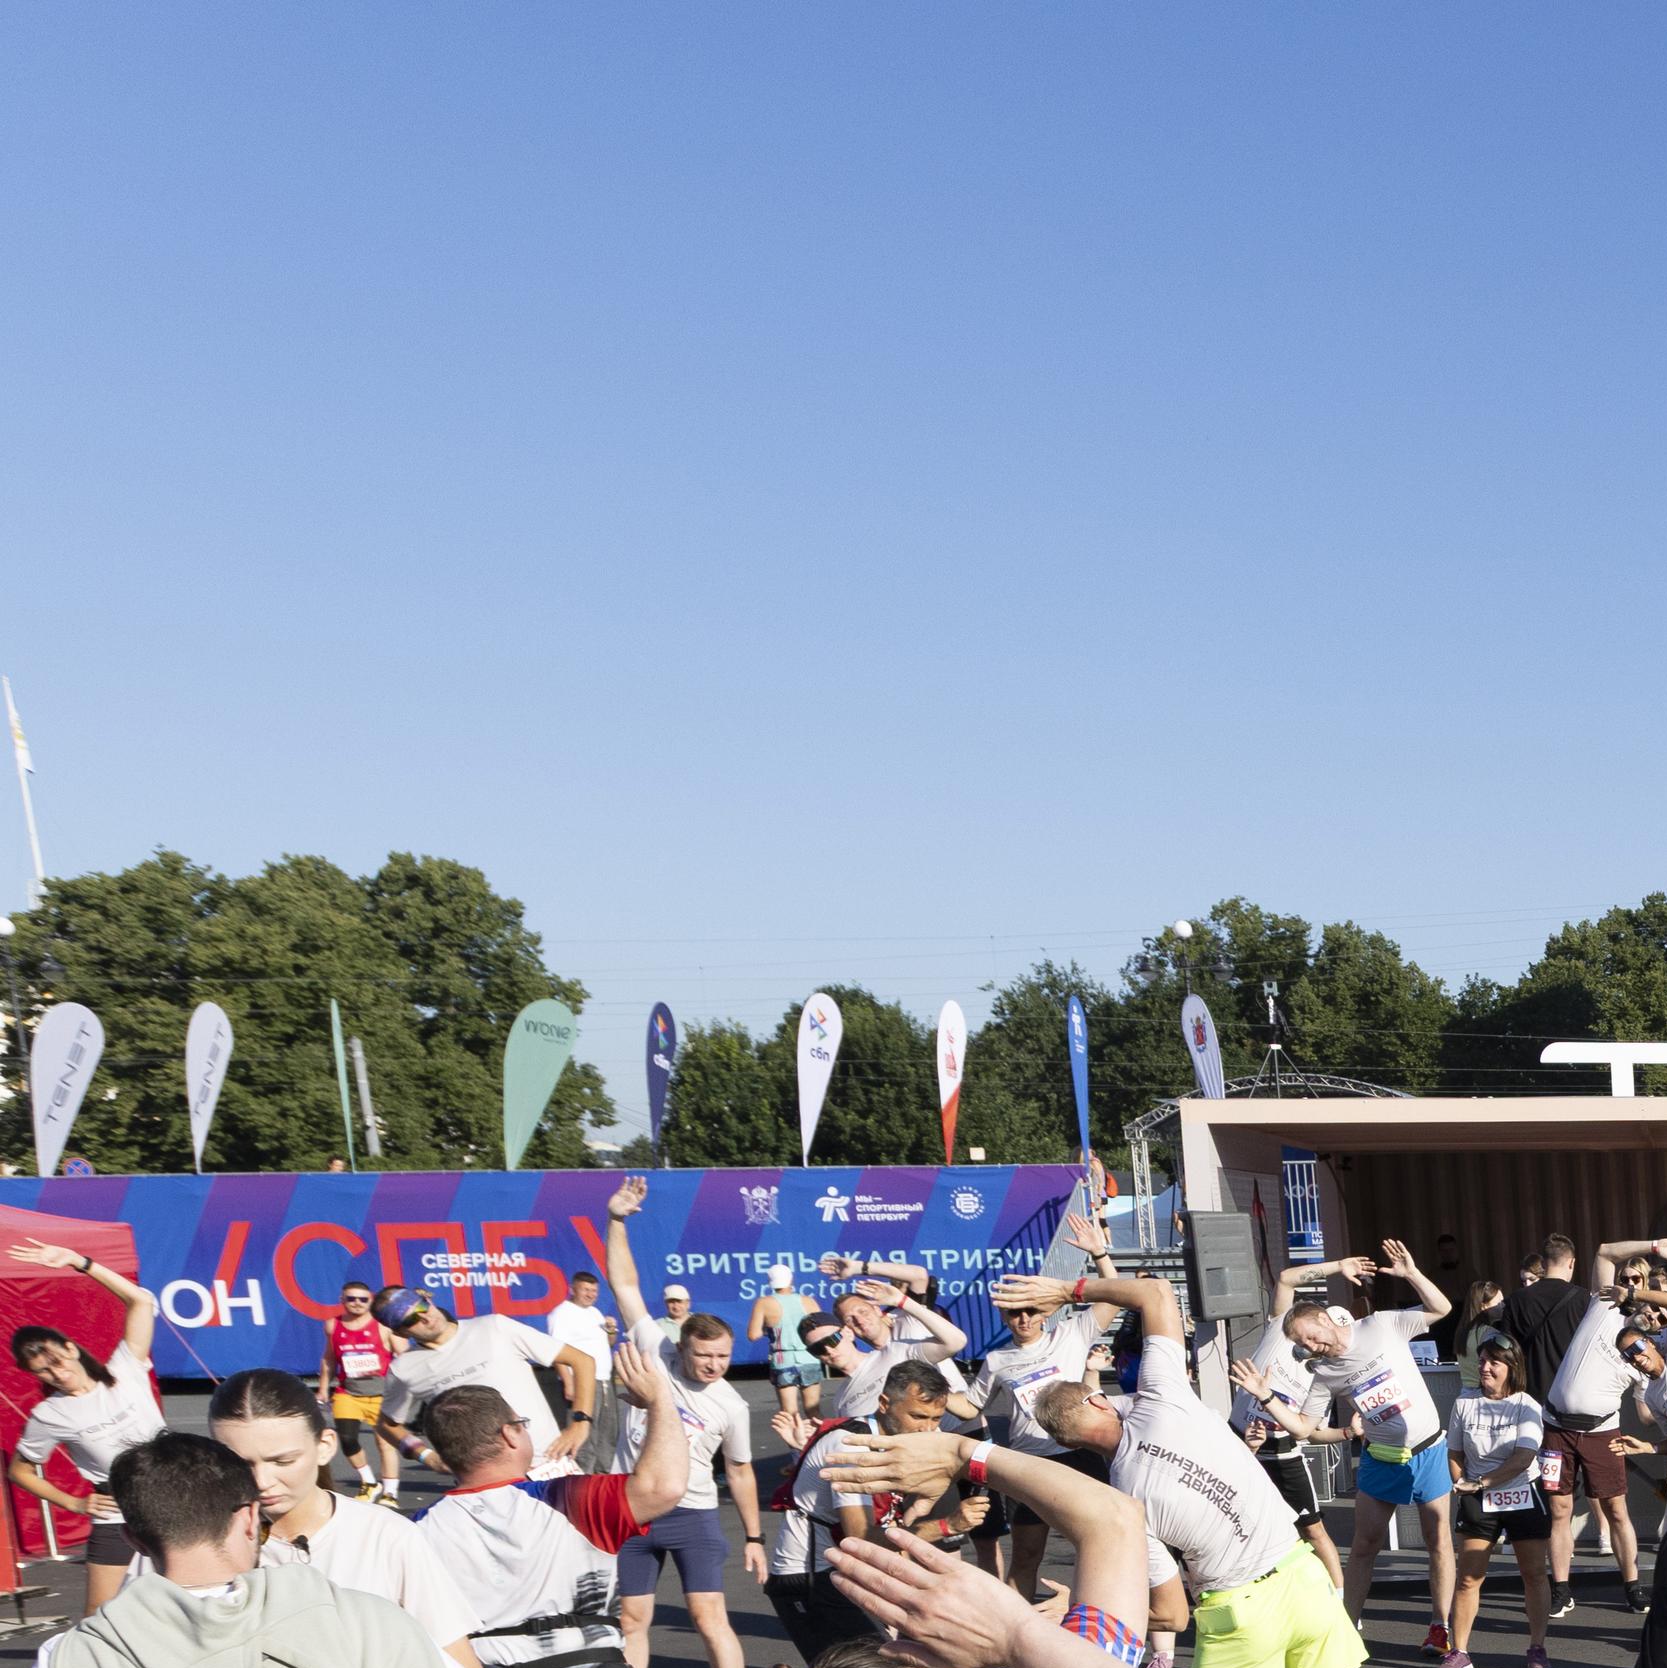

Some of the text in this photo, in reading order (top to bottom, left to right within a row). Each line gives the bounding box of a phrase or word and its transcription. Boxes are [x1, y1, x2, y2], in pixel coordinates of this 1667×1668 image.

[421, 1253, 527, 1269] СЕВЕРНАЯ
[423, 1271, 522, 1289] СТОЛИЦА
[139, 1279, 266, 1328] ОН
[1343, 1353, 1385, 1386] TENET
[1360, 1383, 1402, 1413] 13636
[1484, 1490, 1530, 1507] 13537
